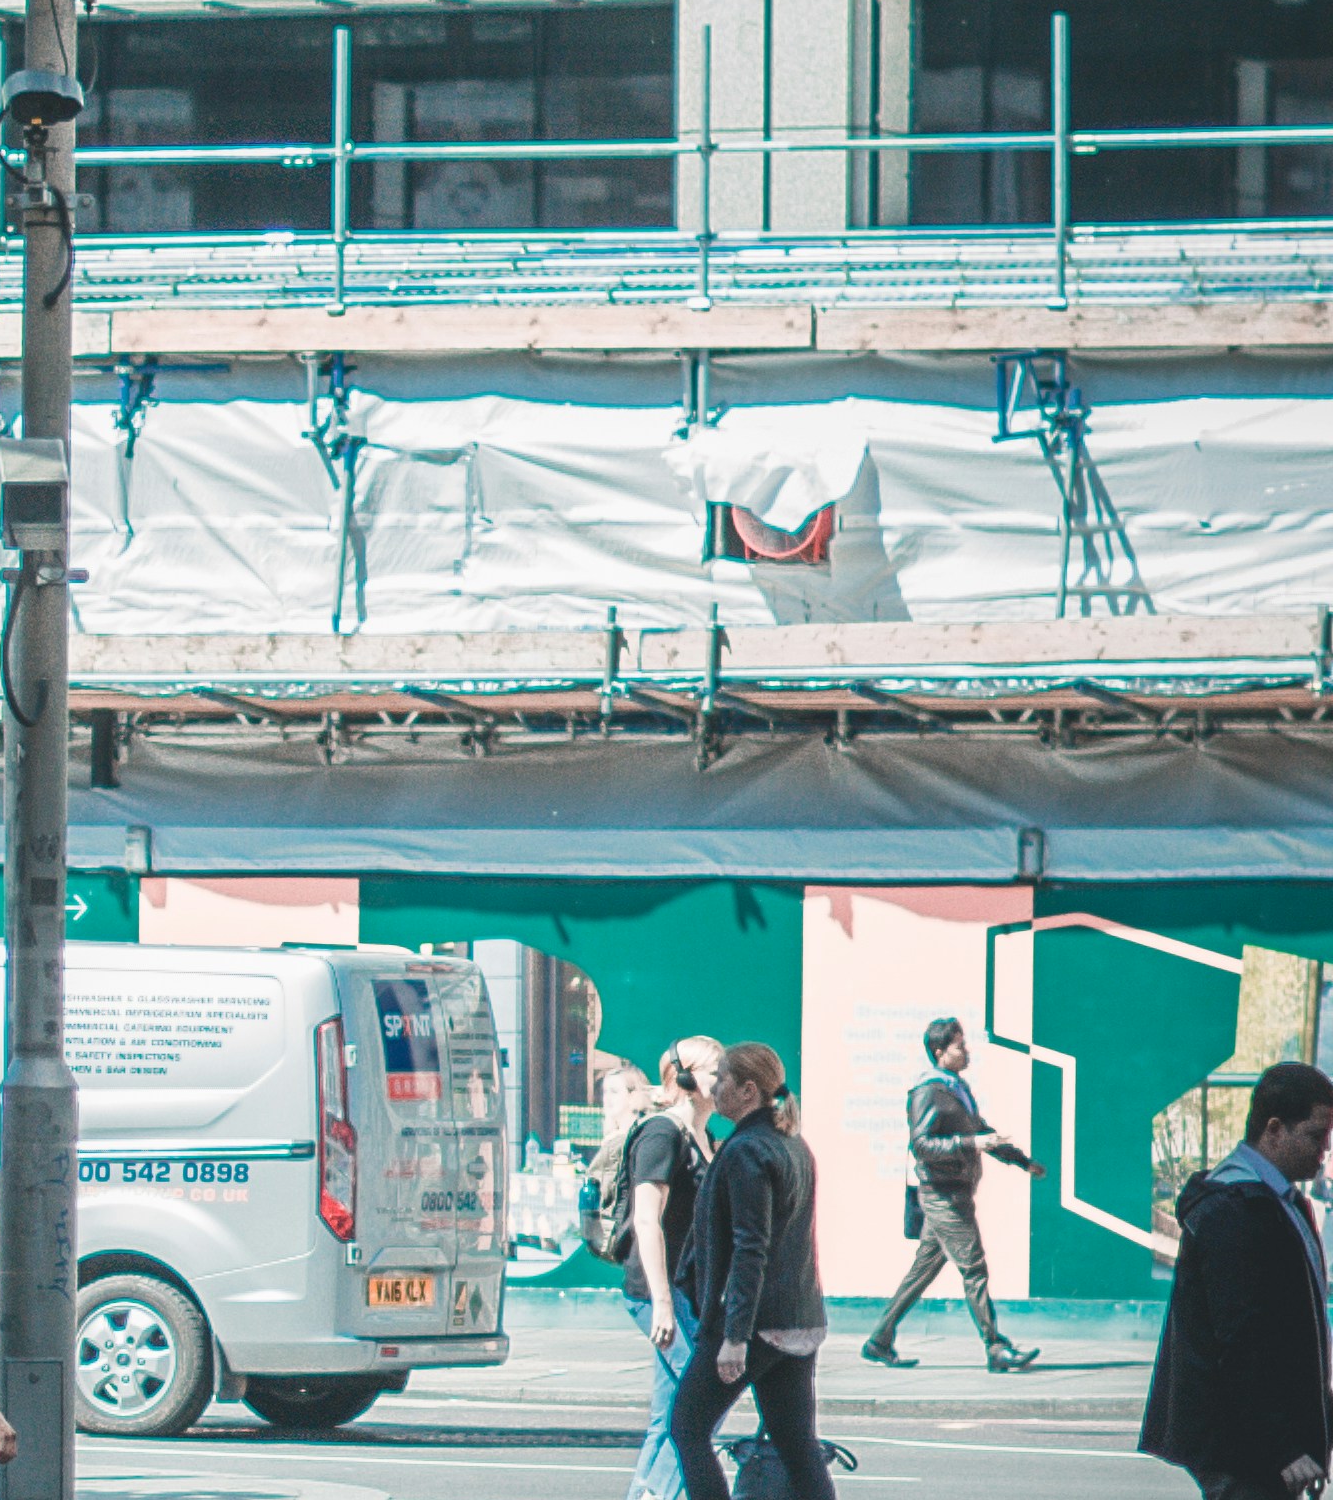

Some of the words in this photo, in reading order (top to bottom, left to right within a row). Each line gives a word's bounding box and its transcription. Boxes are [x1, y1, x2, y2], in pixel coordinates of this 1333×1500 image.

[63, 1007, 121, 1016] OMMERCIAL
[206, 1011, 268, 1020] SPECIALISTS
[176, 1025, 234, 1034] EQUIPMENT
[65, 1037, 116, 1046] NTILATION
[131, 1039, 146, 1047] AIR
[151, 1039, 222, 1048] CONDITIONING
[75, 1051, 112, 1060] SAFETY
[116, 1053, 181, 1061] INSPECTIONS
[106, 1066, 126, 1075] BAR
[130, 1067, 167, 1076] DESIGN
[79, 1162, 111, 1183] 00
[122, 1162, 171, 1183] 542
[183, 1163, 250, 1183] 0898
[422, 1191, 453, 1212] 0800
